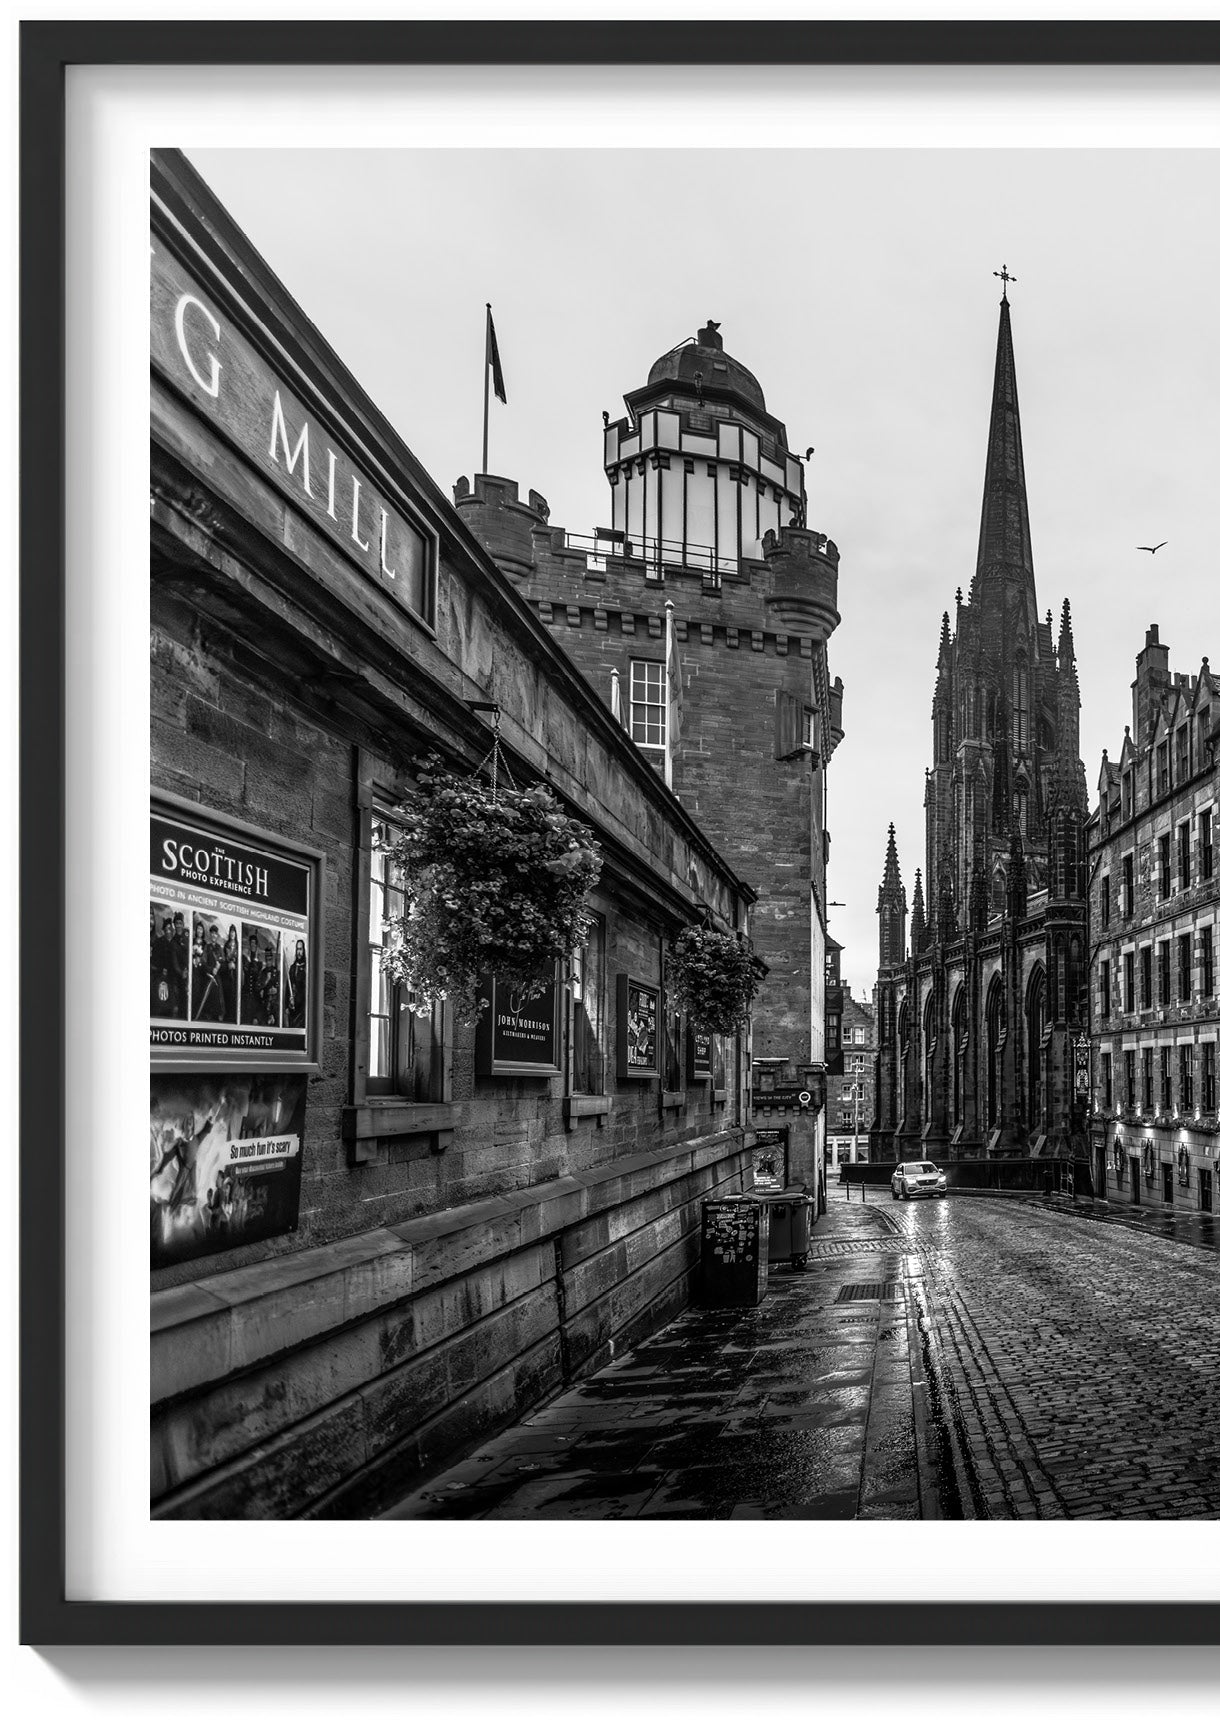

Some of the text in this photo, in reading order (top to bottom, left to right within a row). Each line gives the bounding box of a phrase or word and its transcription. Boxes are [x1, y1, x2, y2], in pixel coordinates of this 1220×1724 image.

[269, 390, 396, 579] MILL
[215, 847, 225, 855] THE
[162, 839, 269, 897] SCOTTISH
[181, 868, 252, 895] PHOTO EXPERIENCE
[177, 890, 186, 900] IN
[187, 894, 218, 907] ANCIENT
[220, 901, 250, 915] SCOTTISH
[281, 916, 305, 929] COSTUME
[497, 1014, 550, 1031] JOHN MORRISON
[190, 1032, 229, 1044] PRINTED
[231, 1035, 274, 1046] INSTANTLY
[230, 1140, 291, 1159] So much fun it's scary
